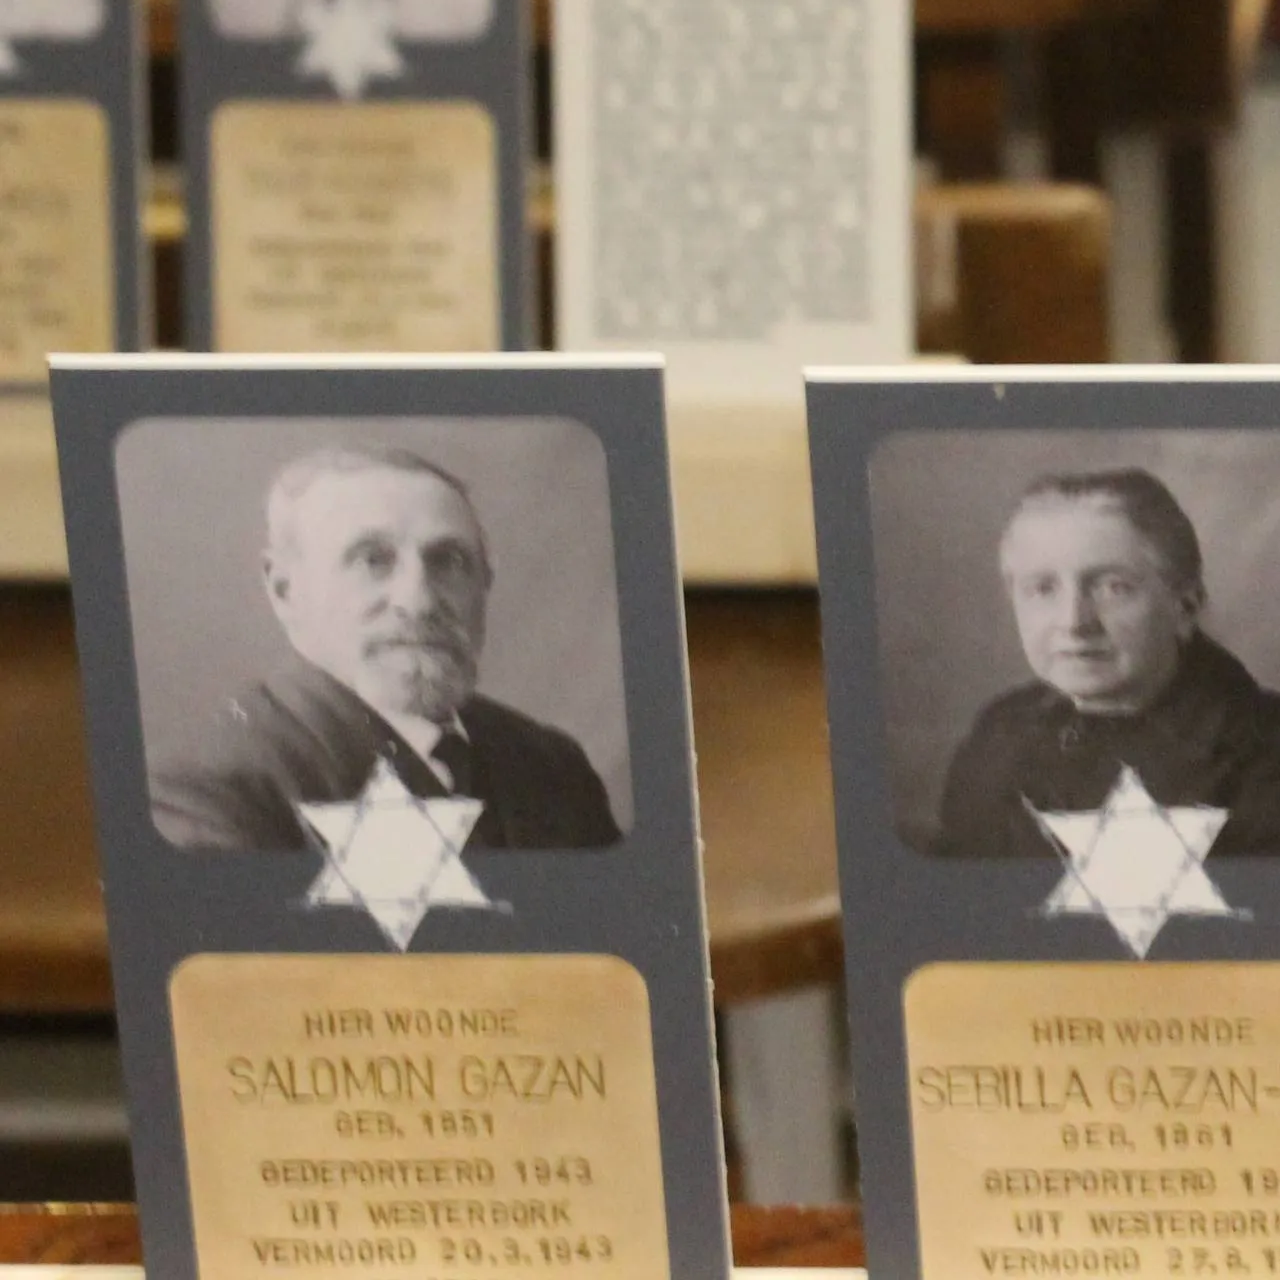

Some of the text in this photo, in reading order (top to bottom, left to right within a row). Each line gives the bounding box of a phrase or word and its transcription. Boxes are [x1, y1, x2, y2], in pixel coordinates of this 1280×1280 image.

[304, 1007, 518, 1039] HIER WOONDE
[1032, 1017, 1255, 1046] HIER WOONDE
[225, 1056, 606, 1104] SALOMON GAZAN
[917, 1065, 1091, 1112] SEBILLA
[261, 1157, 594, 1190] GEDEPORTEERD 1943
[983, 1167, 1216, 1197] GEDEPORTEERD
[290, 1198, 571, 1230] UIT WESTERBORK
[1012, 1211, 1063, 1239] UIT
[251, 1237, 417, 1266] VERMOORD
[977, 1246, 1142, 1277] VERMOORD
